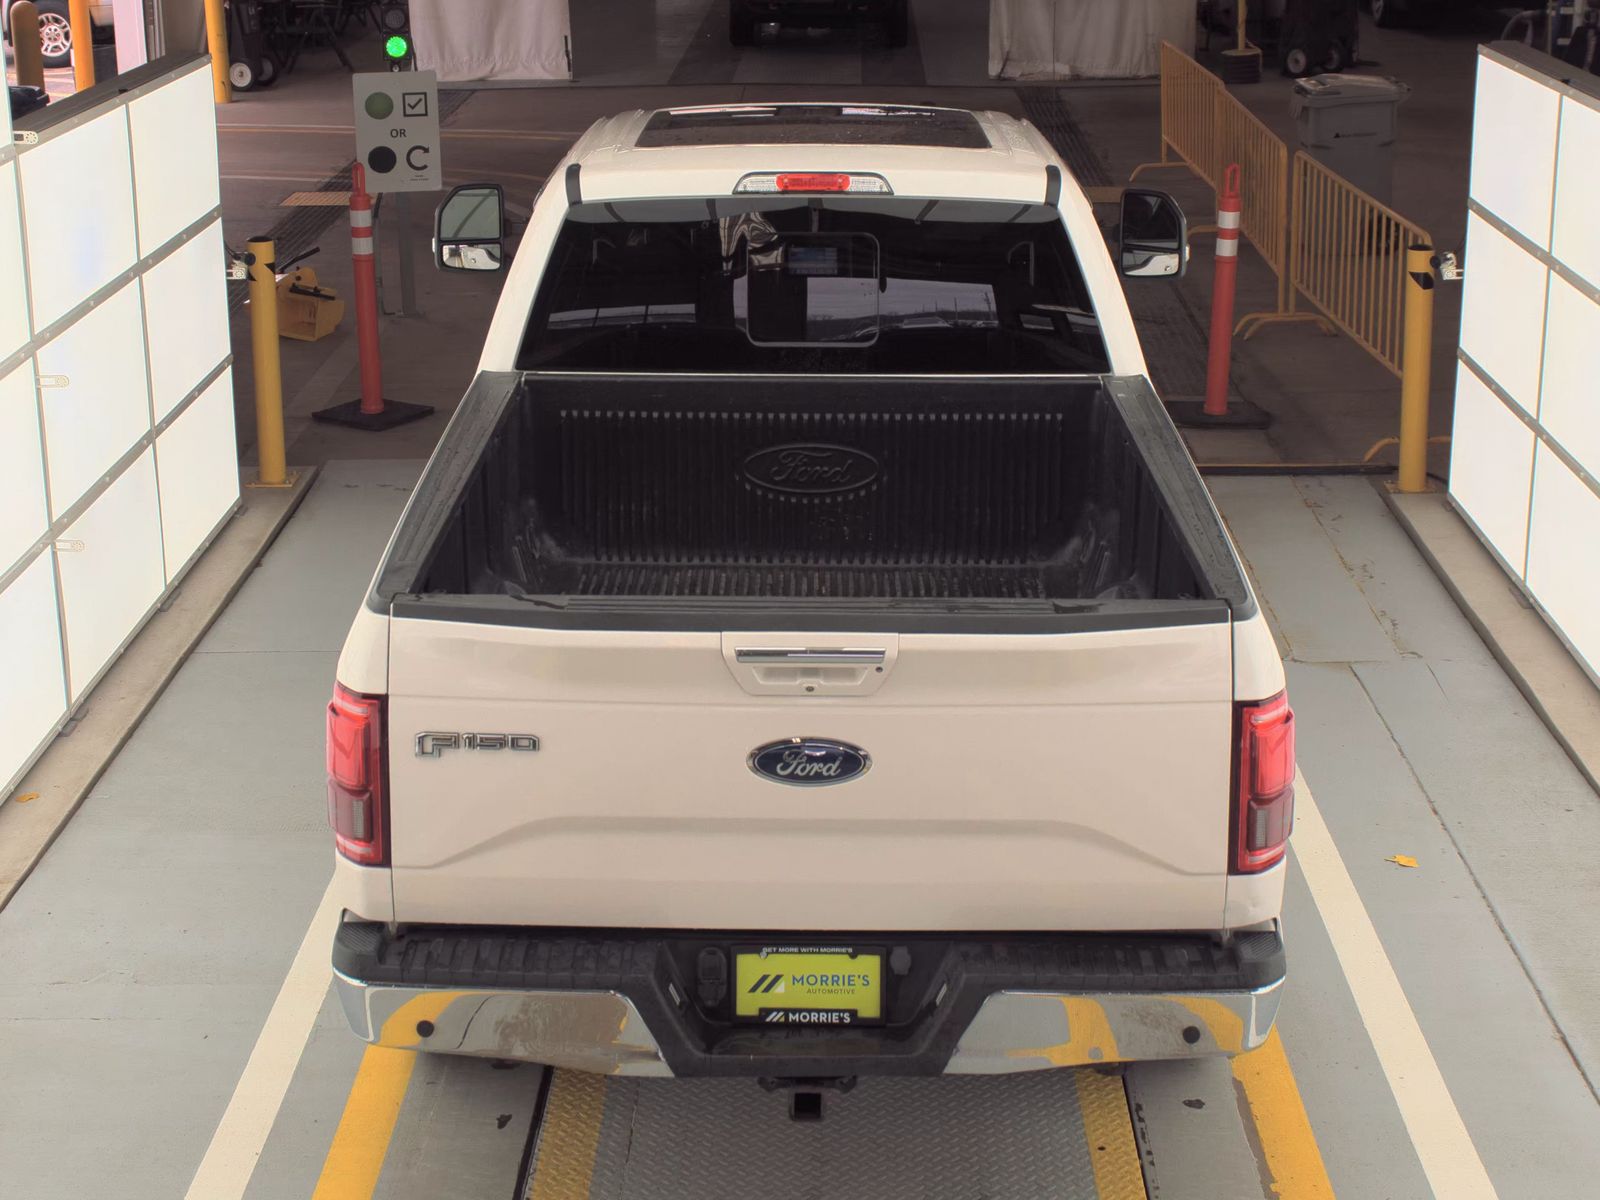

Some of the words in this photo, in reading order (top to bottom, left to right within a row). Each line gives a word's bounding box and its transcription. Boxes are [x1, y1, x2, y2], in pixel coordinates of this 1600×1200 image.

[390, 128, 407, 138] OR
[767, 449, 853, 482] Ford
[775, 748, 843, 777] Ford
[820, 946, 853, 954] MORRIE'S
[791, 974, 870, 987] MORRIE'S
[788, 1011, 851, 1024] MORRIE'S
